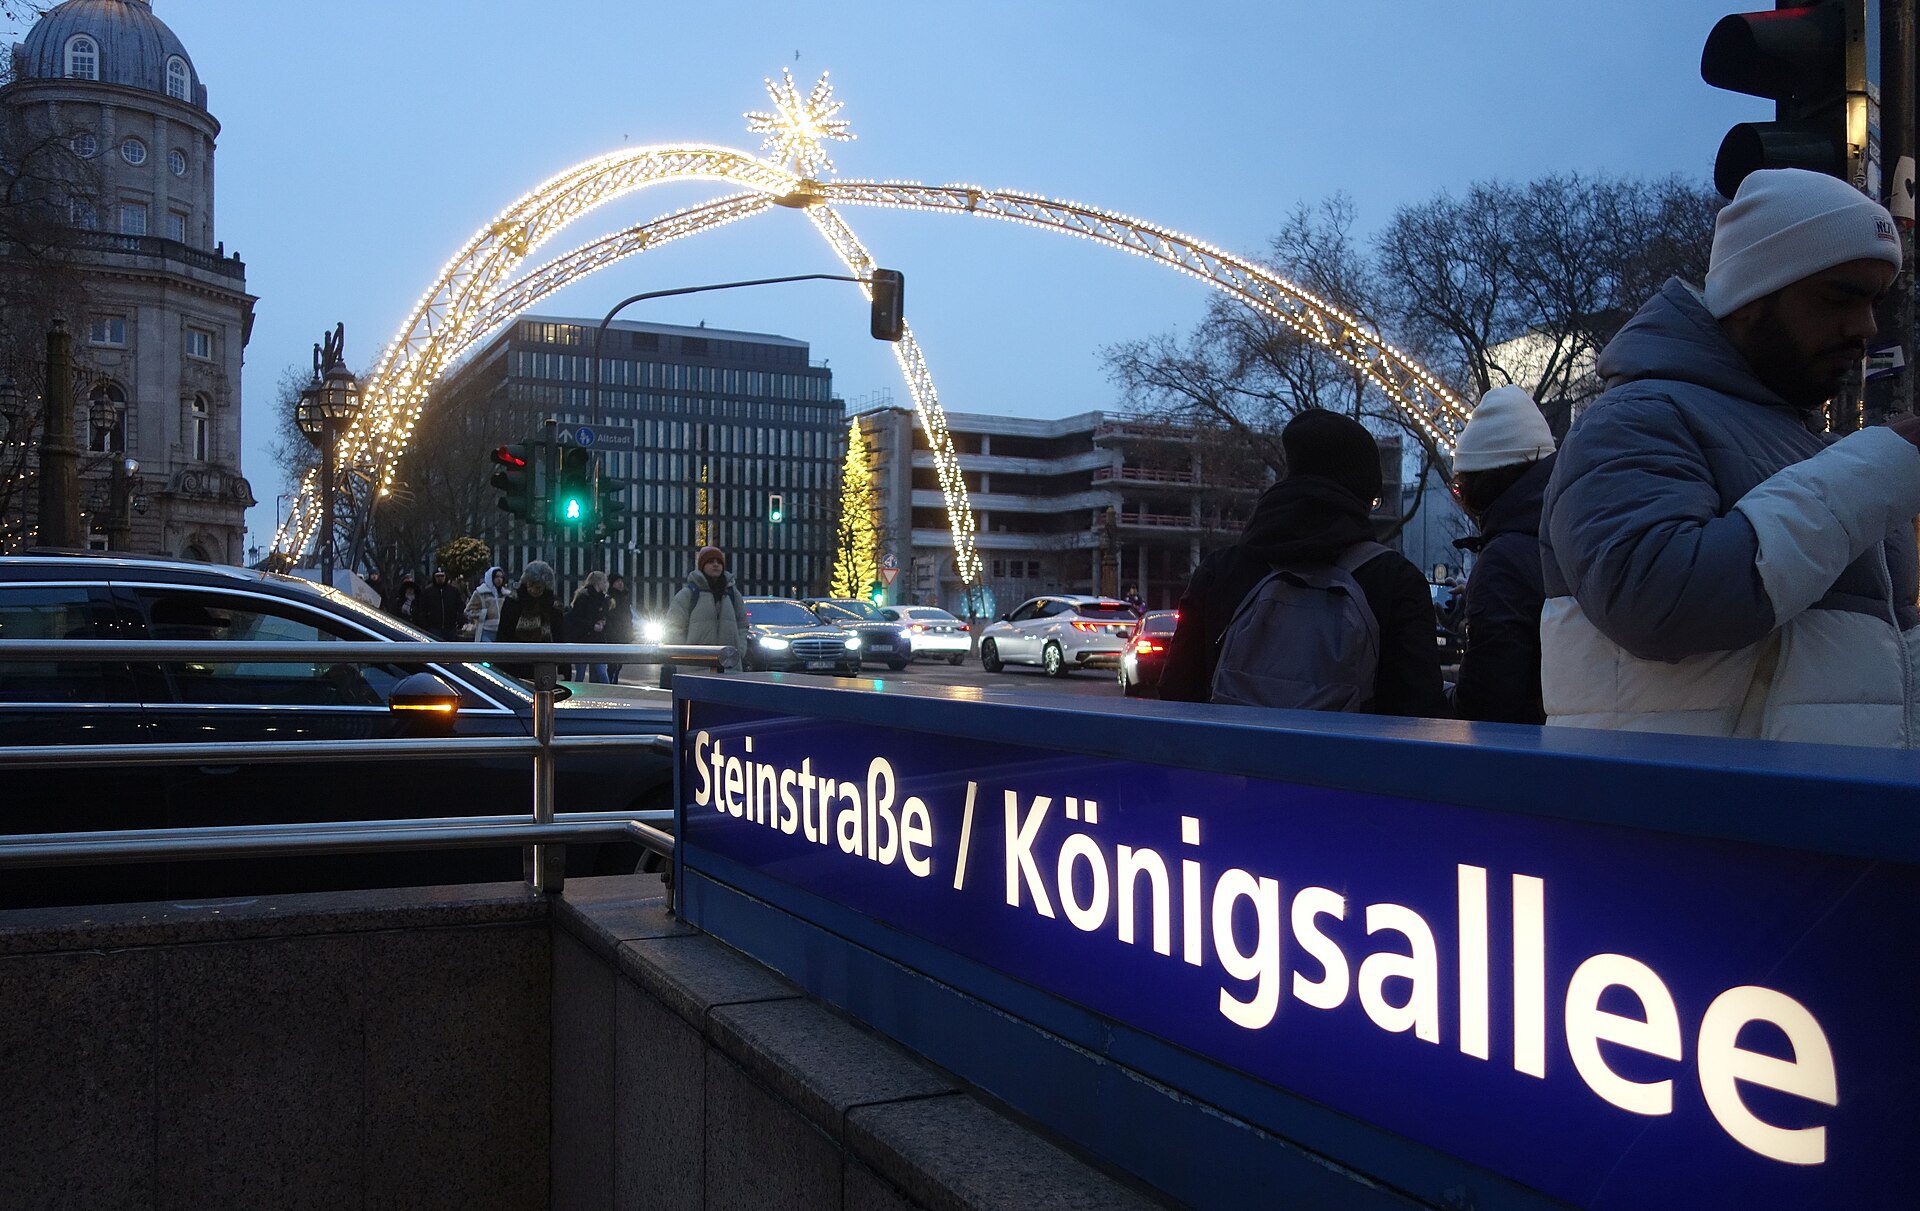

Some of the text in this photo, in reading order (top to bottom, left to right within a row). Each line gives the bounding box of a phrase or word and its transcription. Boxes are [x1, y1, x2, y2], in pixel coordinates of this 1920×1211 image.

[597, 434, 631, 444] Altstadt
[694, 730, 1838, 1165] Steinstraße / Königsallee
